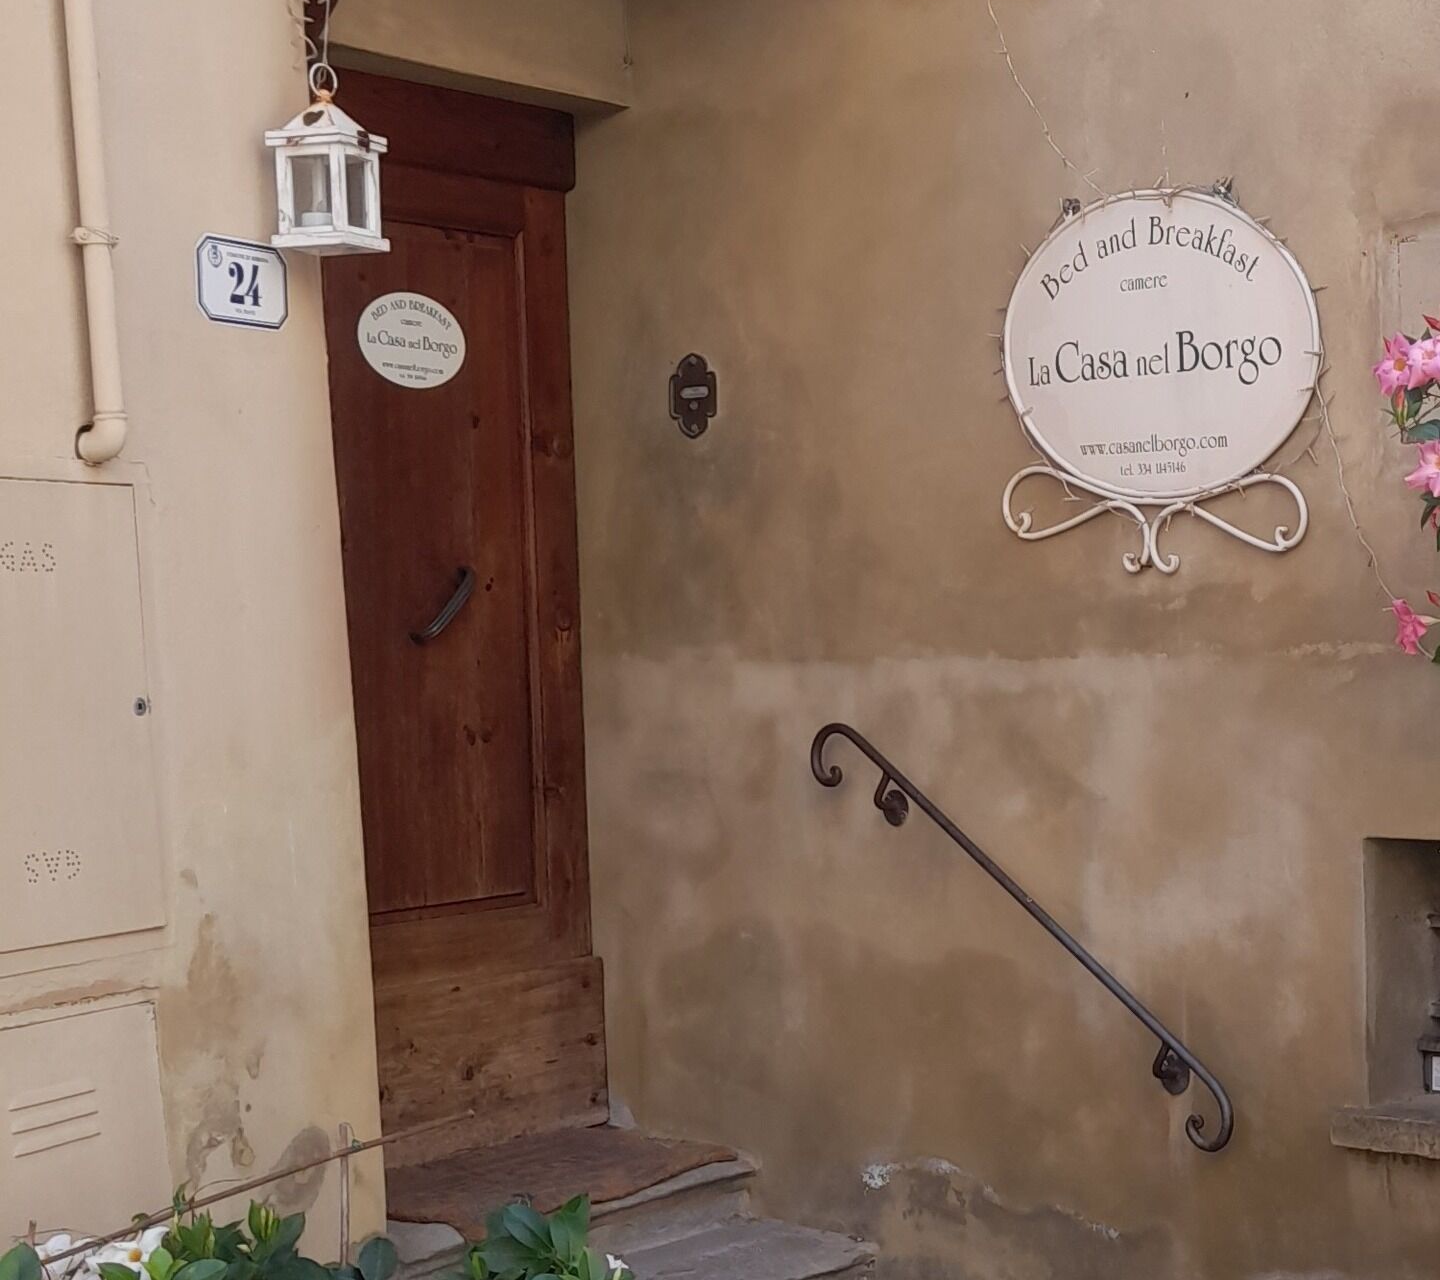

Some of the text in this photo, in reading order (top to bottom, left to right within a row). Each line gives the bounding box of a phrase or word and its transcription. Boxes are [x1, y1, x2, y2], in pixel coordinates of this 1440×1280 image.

[1039, 215, 1260, 301] Bed and Breakfast
[228, 261, 263, 308] 24
[1119, 274, 1169, 292] camere
[370, 303, 389, 321] BED
[390, 299, 407, 311] AND
[366, 331, 377, 344] La
[377, 330, 406, 348] Casa
[422, 335, 458, 359] Borgo
[1027, 330, 1283, 387] La Casa nel Borgo
[1079, 433, 1229, 458] www.casanelborgo.com
[0, 541, 57, 573] GAS
